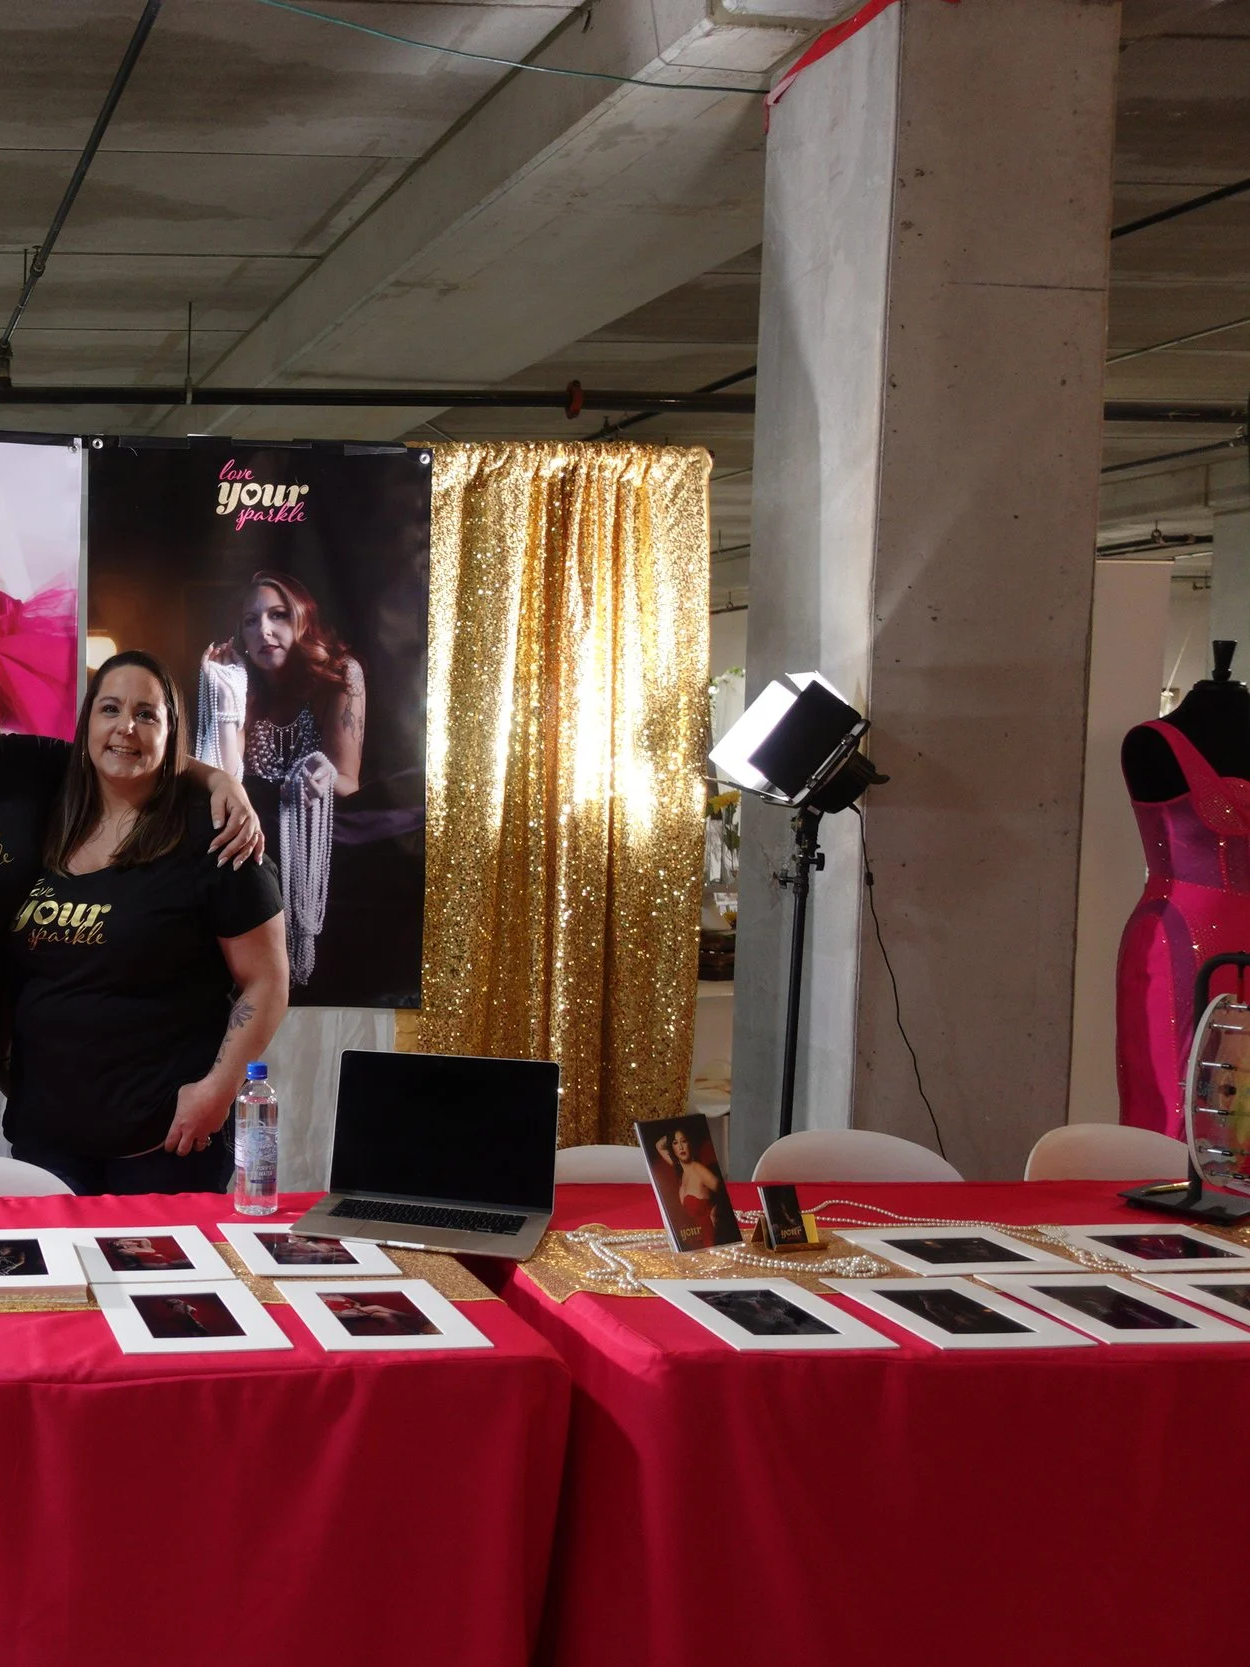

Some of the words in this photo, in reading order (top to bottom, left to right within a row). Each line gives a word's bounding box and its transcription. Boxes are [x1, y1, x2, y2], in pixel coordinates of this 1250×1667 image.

[219, 459, 254, 480] love
[216, 482, 309, 515] your
[235, 501, 307, 531] sparkle
[28, 921, 107, 950] sparkle
